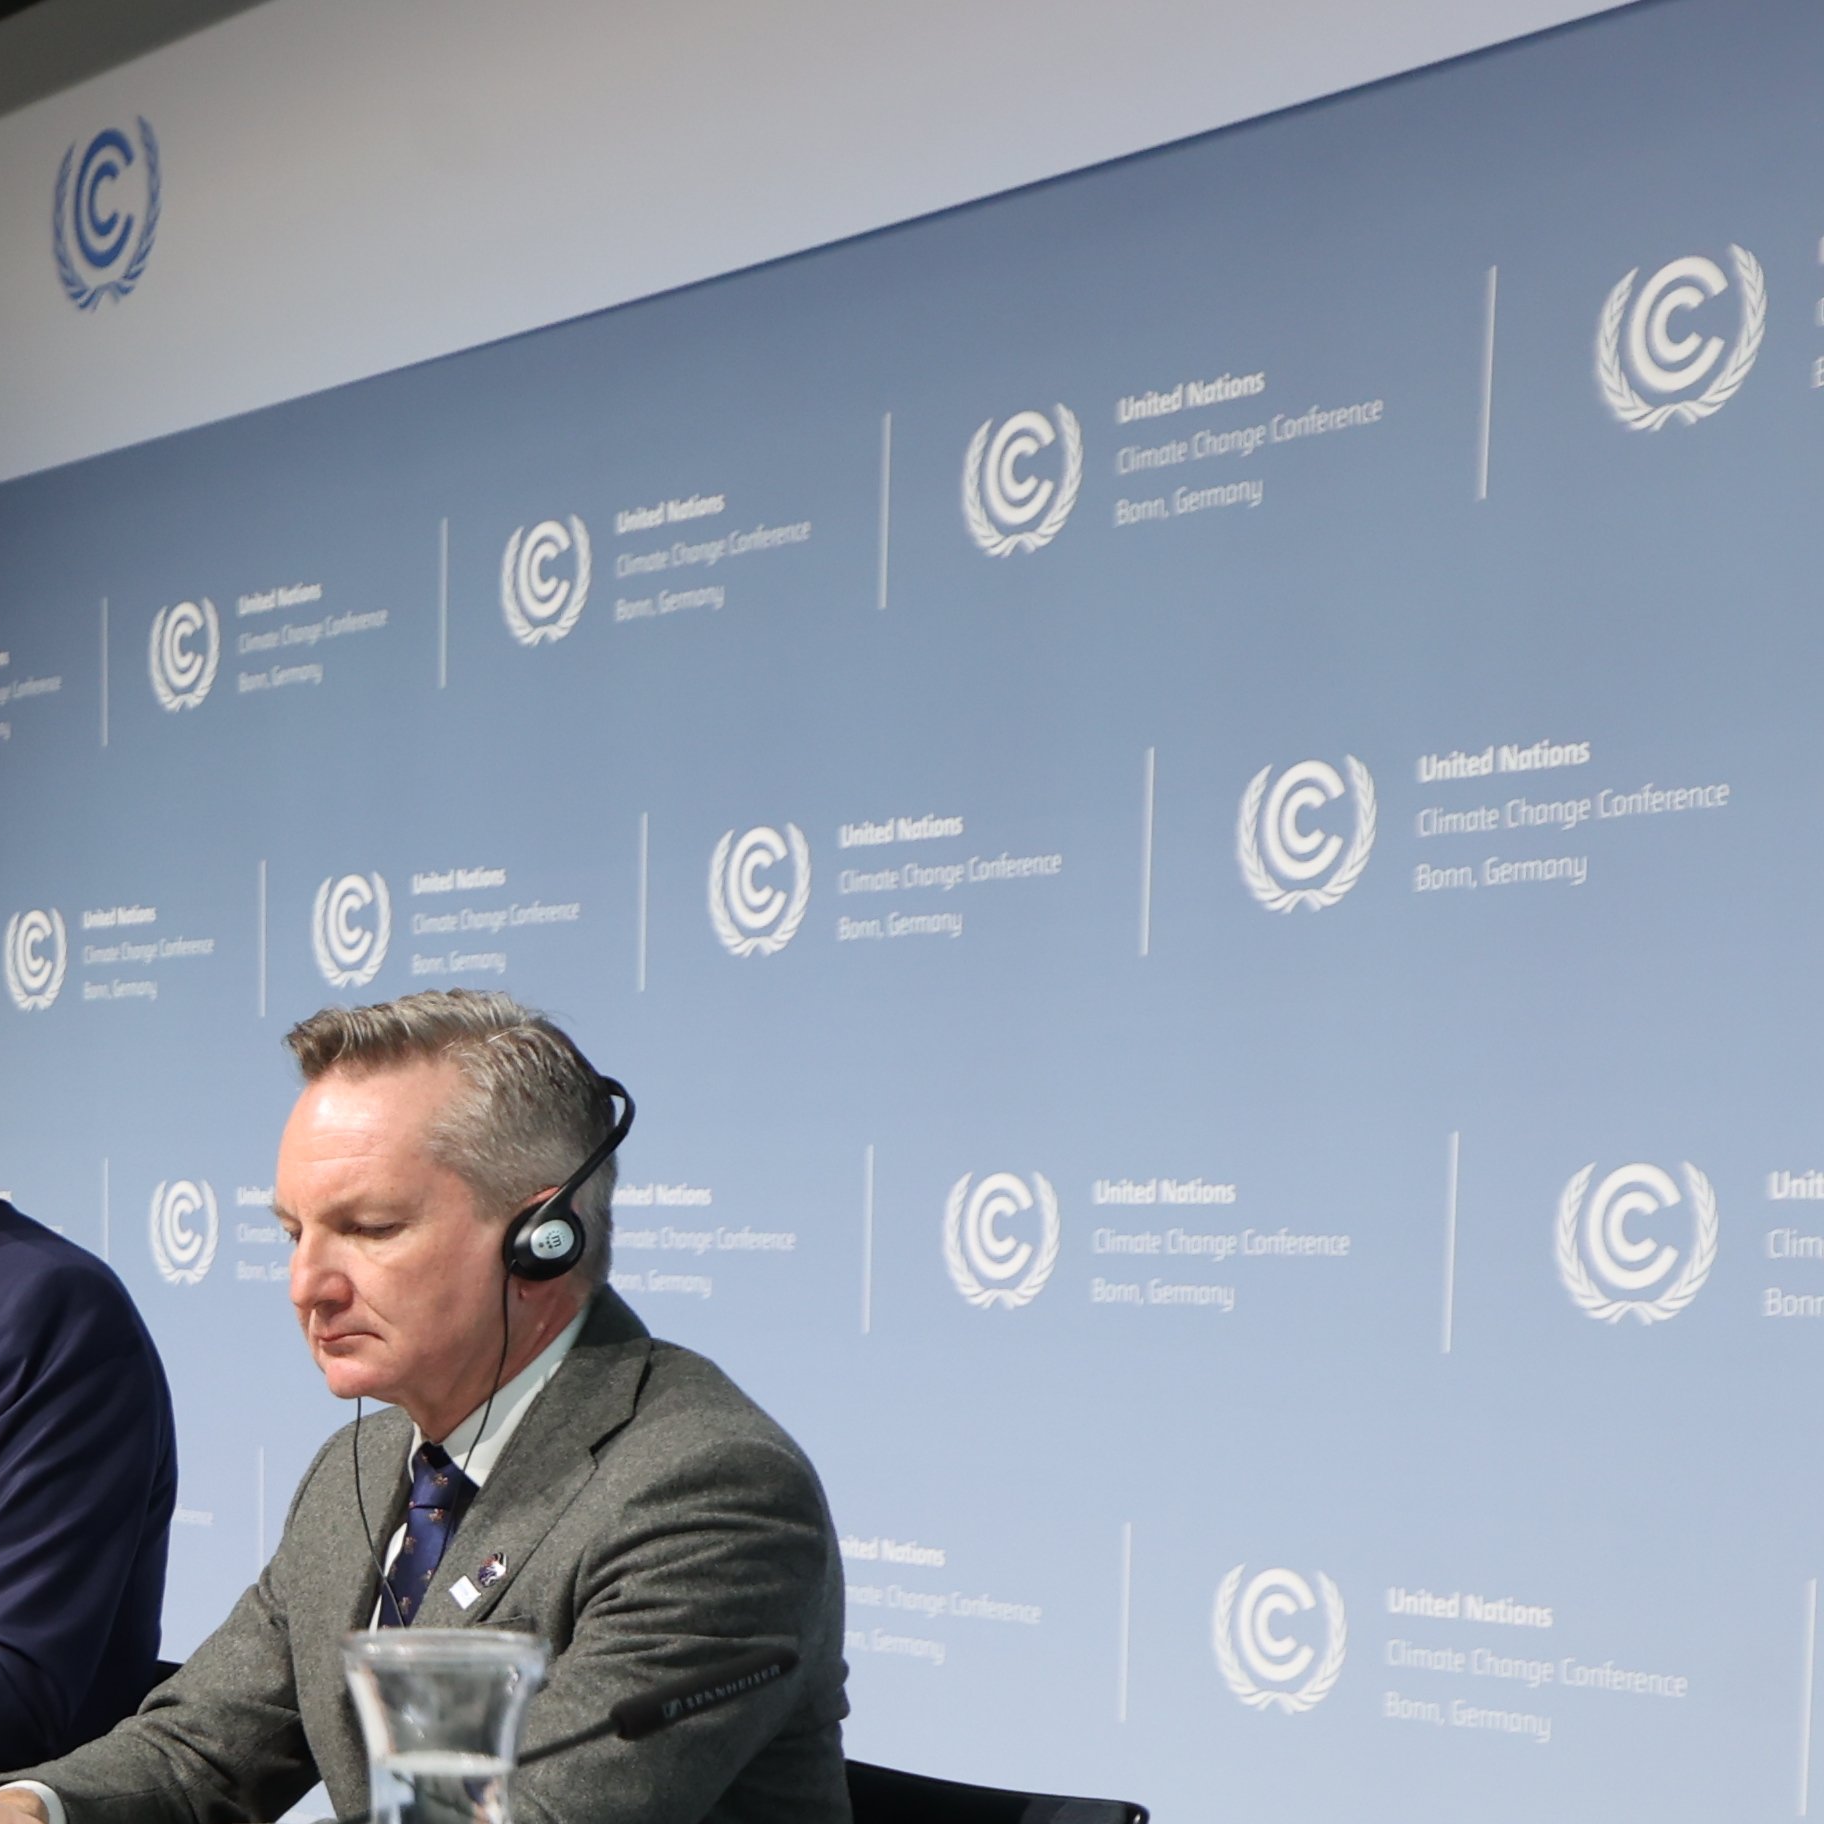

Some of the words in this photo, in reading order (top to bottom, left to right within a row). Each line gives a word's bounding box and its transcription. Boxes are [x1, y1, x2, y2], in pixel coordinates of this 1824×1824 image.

[1116, 384, 1183, 423] United
[1186, 371, 1265, 406] Nations
[1117, 440, 1188, 474] Climate
[1192, 424, 1266, 459] Change
[1272, 399, 1383, 443] Conference
[616, 501, 664, 534] United
[667, 493, 725, 522] Nations
[1115, 498, 1169, 527] Bonn,
[1175, 480, 1264, 515] Germany
[617, 551, 669, 578] Climate
[671, 540, 726, 566] Change
[729, 521, 811, 554] Conference
[615, 598, 656, 622] Bonn,
[659, 585, 725, 614] Germany
[1418, 746, 1494, 783] United
[1499, 739, 1590, 772] Nations
[1418, 806, 1499, 838] Climate
[1505, 798, 1591, 831] Change
[1598, 783, 1730, 818] Conference
[840, 818, 894, 848] United
[897, 813, 963, 841] Nations
[413, 869, 454, 894] United
[456, 866, 506, 889] Nations
[841, 869, 899, 894] Climate
[903, 862, 965, 891] Change
[968, 852, 1062, 882] Conference
[1413, 863, 1477, 892] Bonn,
[1484, 855, 1588, 887] Germany
[838, 916, 885, 941] Bonn,
[888, 911, 962, 939] Germany
[612, 1183, 654, 1206] nited
[656, 1183, 712, 1206] Nations
[1093, 1178, 1157, 1205] United
[1160, 1177, 1236, 1205] Nations
[612, 1226, 658, 1249] limate
[1094, 1227, 1162, 1254] Climate
[1166, 1228, 1238, 1262] Change
[1242, 1227, 1350, 1256] Conference
[1092, 1277, 1144, 1306] Bonn,
[1148, 1277, 1234, 1313] Germany
[840, 1534, 879, 1560] nited
[881, 1539, 946, 1568] Nations
[1387, 1587, 1460, 1618] United
[1465, 1594, 1554, 1627] Nations
[1386, 1638, 1465, 1673] Climate
[1471, 1647, 1554, 1688] Change
[1560, 1656, 1689, 1698] Conference
[1384, 1691, 1445, 1726] Bonn,
[1451, 1699, 1552, 1743] Germany
